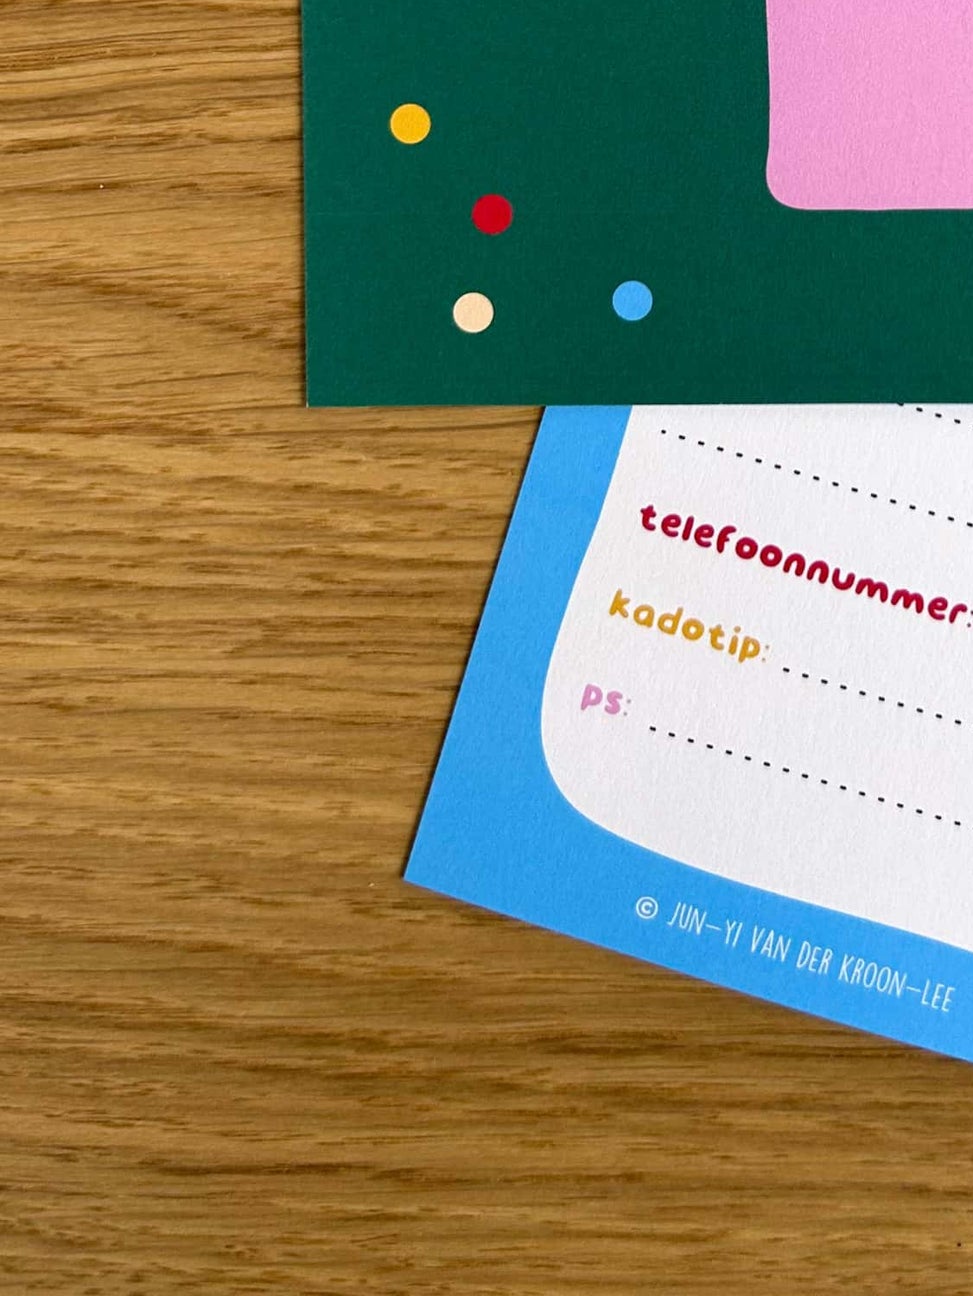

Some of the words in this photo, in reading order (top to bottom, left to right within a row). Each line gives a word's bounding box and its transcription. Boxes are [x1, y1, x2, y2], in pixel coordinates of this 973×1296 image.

[608, 588, 771, 664] kadotip:
[580, 683, 633, 717] ps:
[667, 901, 742, 949] JUN-YI
[750, 929, 791, 963] VAN
[796, 941, 834, 976] DER
[837, 954, 957, 1014] KROON-LEE
